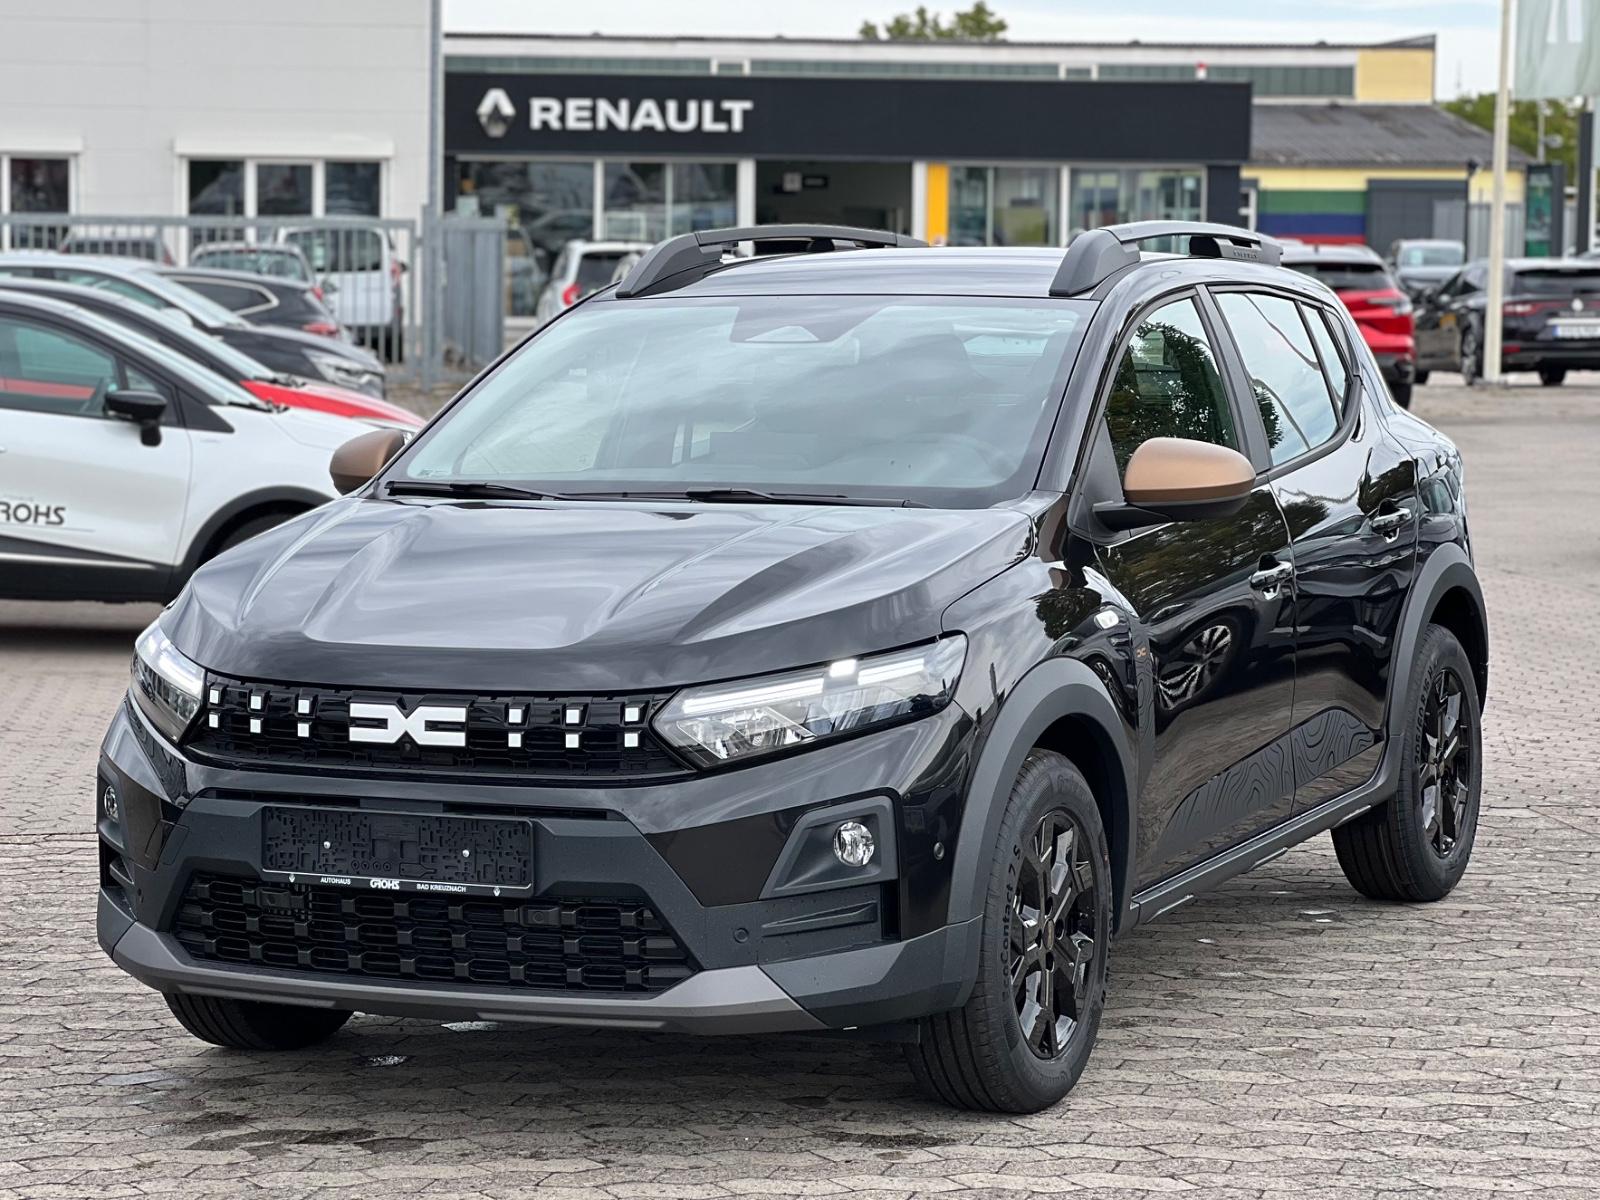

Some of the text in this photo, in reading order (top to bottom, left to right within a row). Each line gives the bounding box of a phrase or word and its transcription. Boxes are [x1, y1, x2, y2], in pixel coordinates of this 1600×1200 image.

[529, 97, 754, 133] RENAULT
[0, 502, 66, 526] ROHS
[320, 876, 351, 885] AUTOHAUS
[369, 879, 400, 890] GROHS
[430, 884, 467, 893] KREUZNACH
